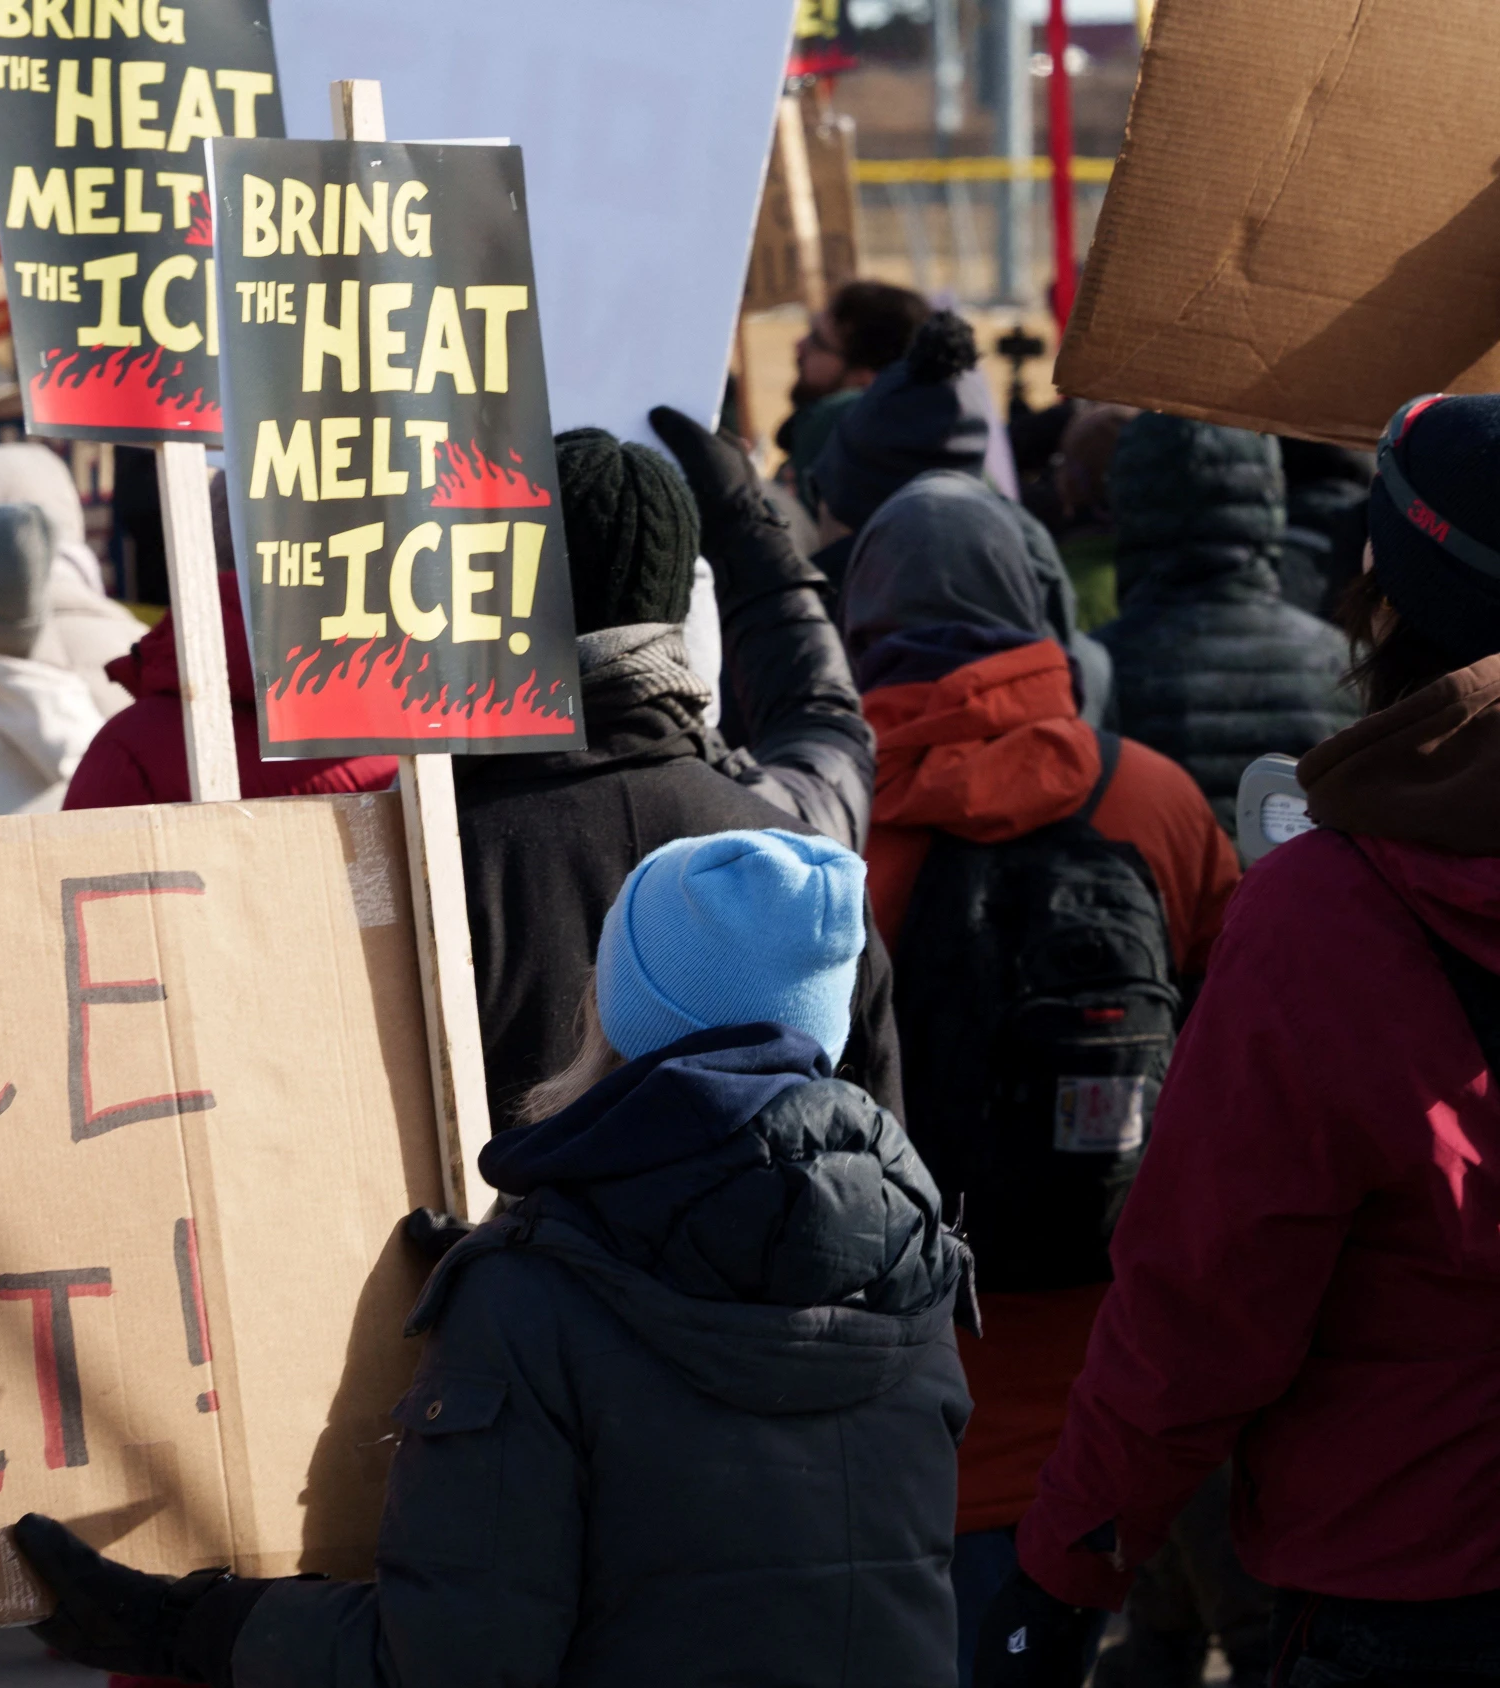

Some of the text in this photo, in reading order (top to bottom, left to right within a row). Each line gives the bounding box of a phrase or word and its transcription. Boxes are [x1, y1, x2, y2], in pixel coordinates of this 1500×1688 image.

[55, 57, 273, 153] HEAT
[6, 166, 204, 235] MELT
[242, 174, 433, 258] BRING
[14, 252, 220, 356] THE IC
[235, 279, 529, 394] THE HEAT
[249, 416, 449, 502] MELT
[1406, 498, 1451, 544] 3M
[255, 521, 547, 656] THE ICE!
